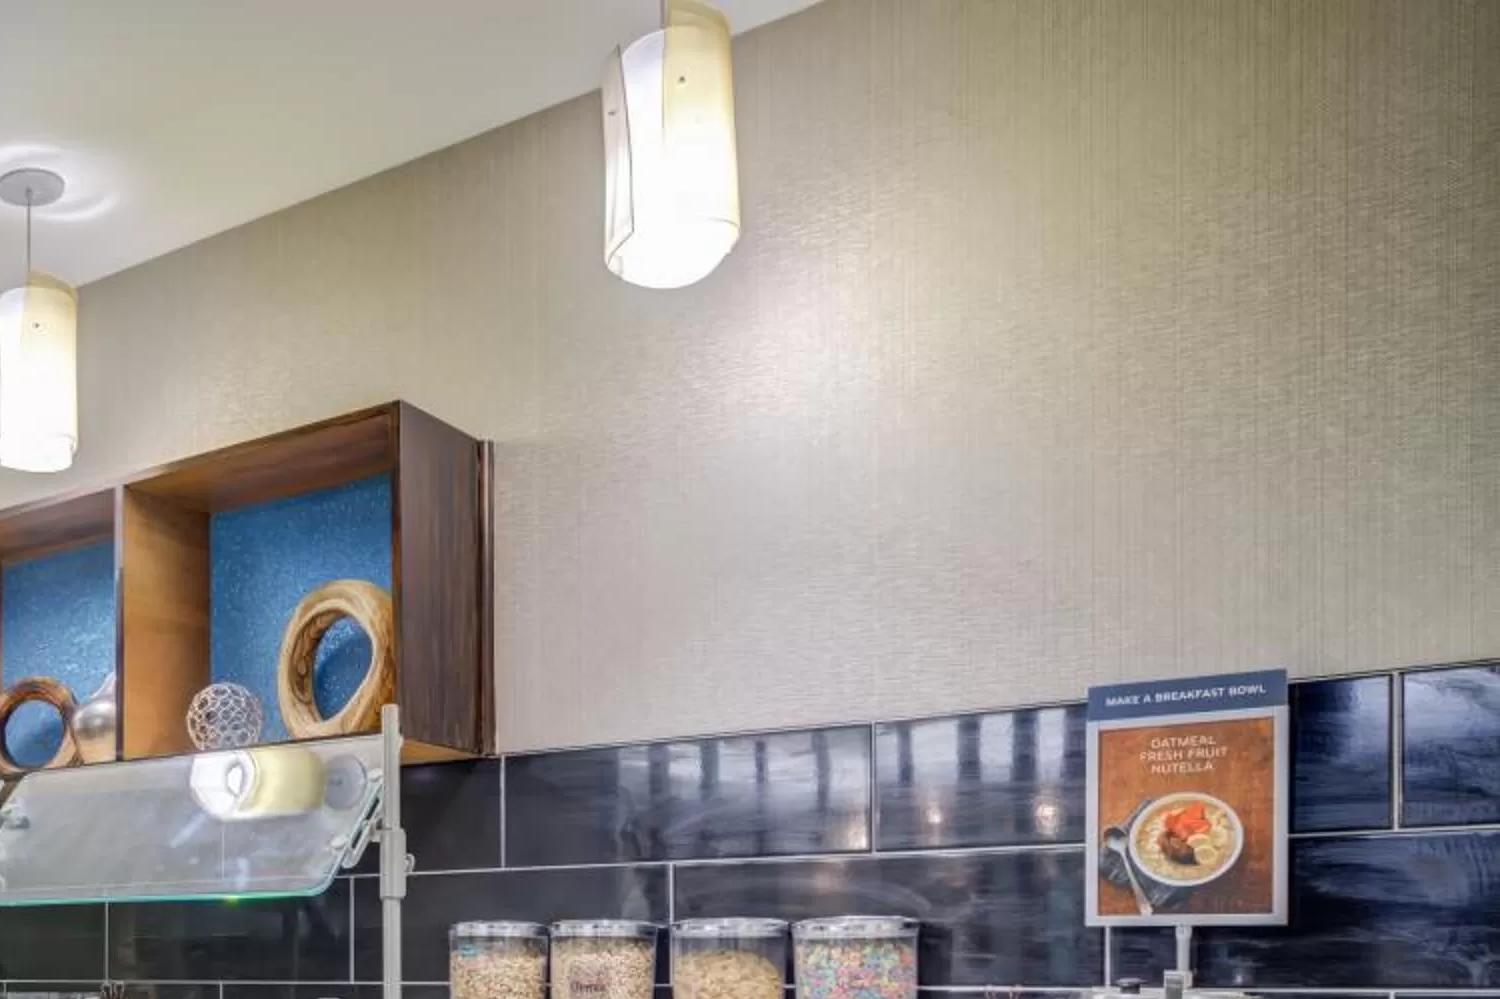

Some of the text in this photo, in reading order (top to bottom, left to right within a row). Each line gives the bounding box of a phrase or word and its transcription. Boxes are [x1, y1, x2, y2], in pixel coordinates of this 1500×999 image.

[1105, 683, 1267, 707] MAKE A BREAKFAST BOWL
[1151, 735, 1217, 749] OATMEAL
[1139, 746, 1229, 761] FRESH FRUIT
[1151, 761, 1215, 774] NUTELLA
